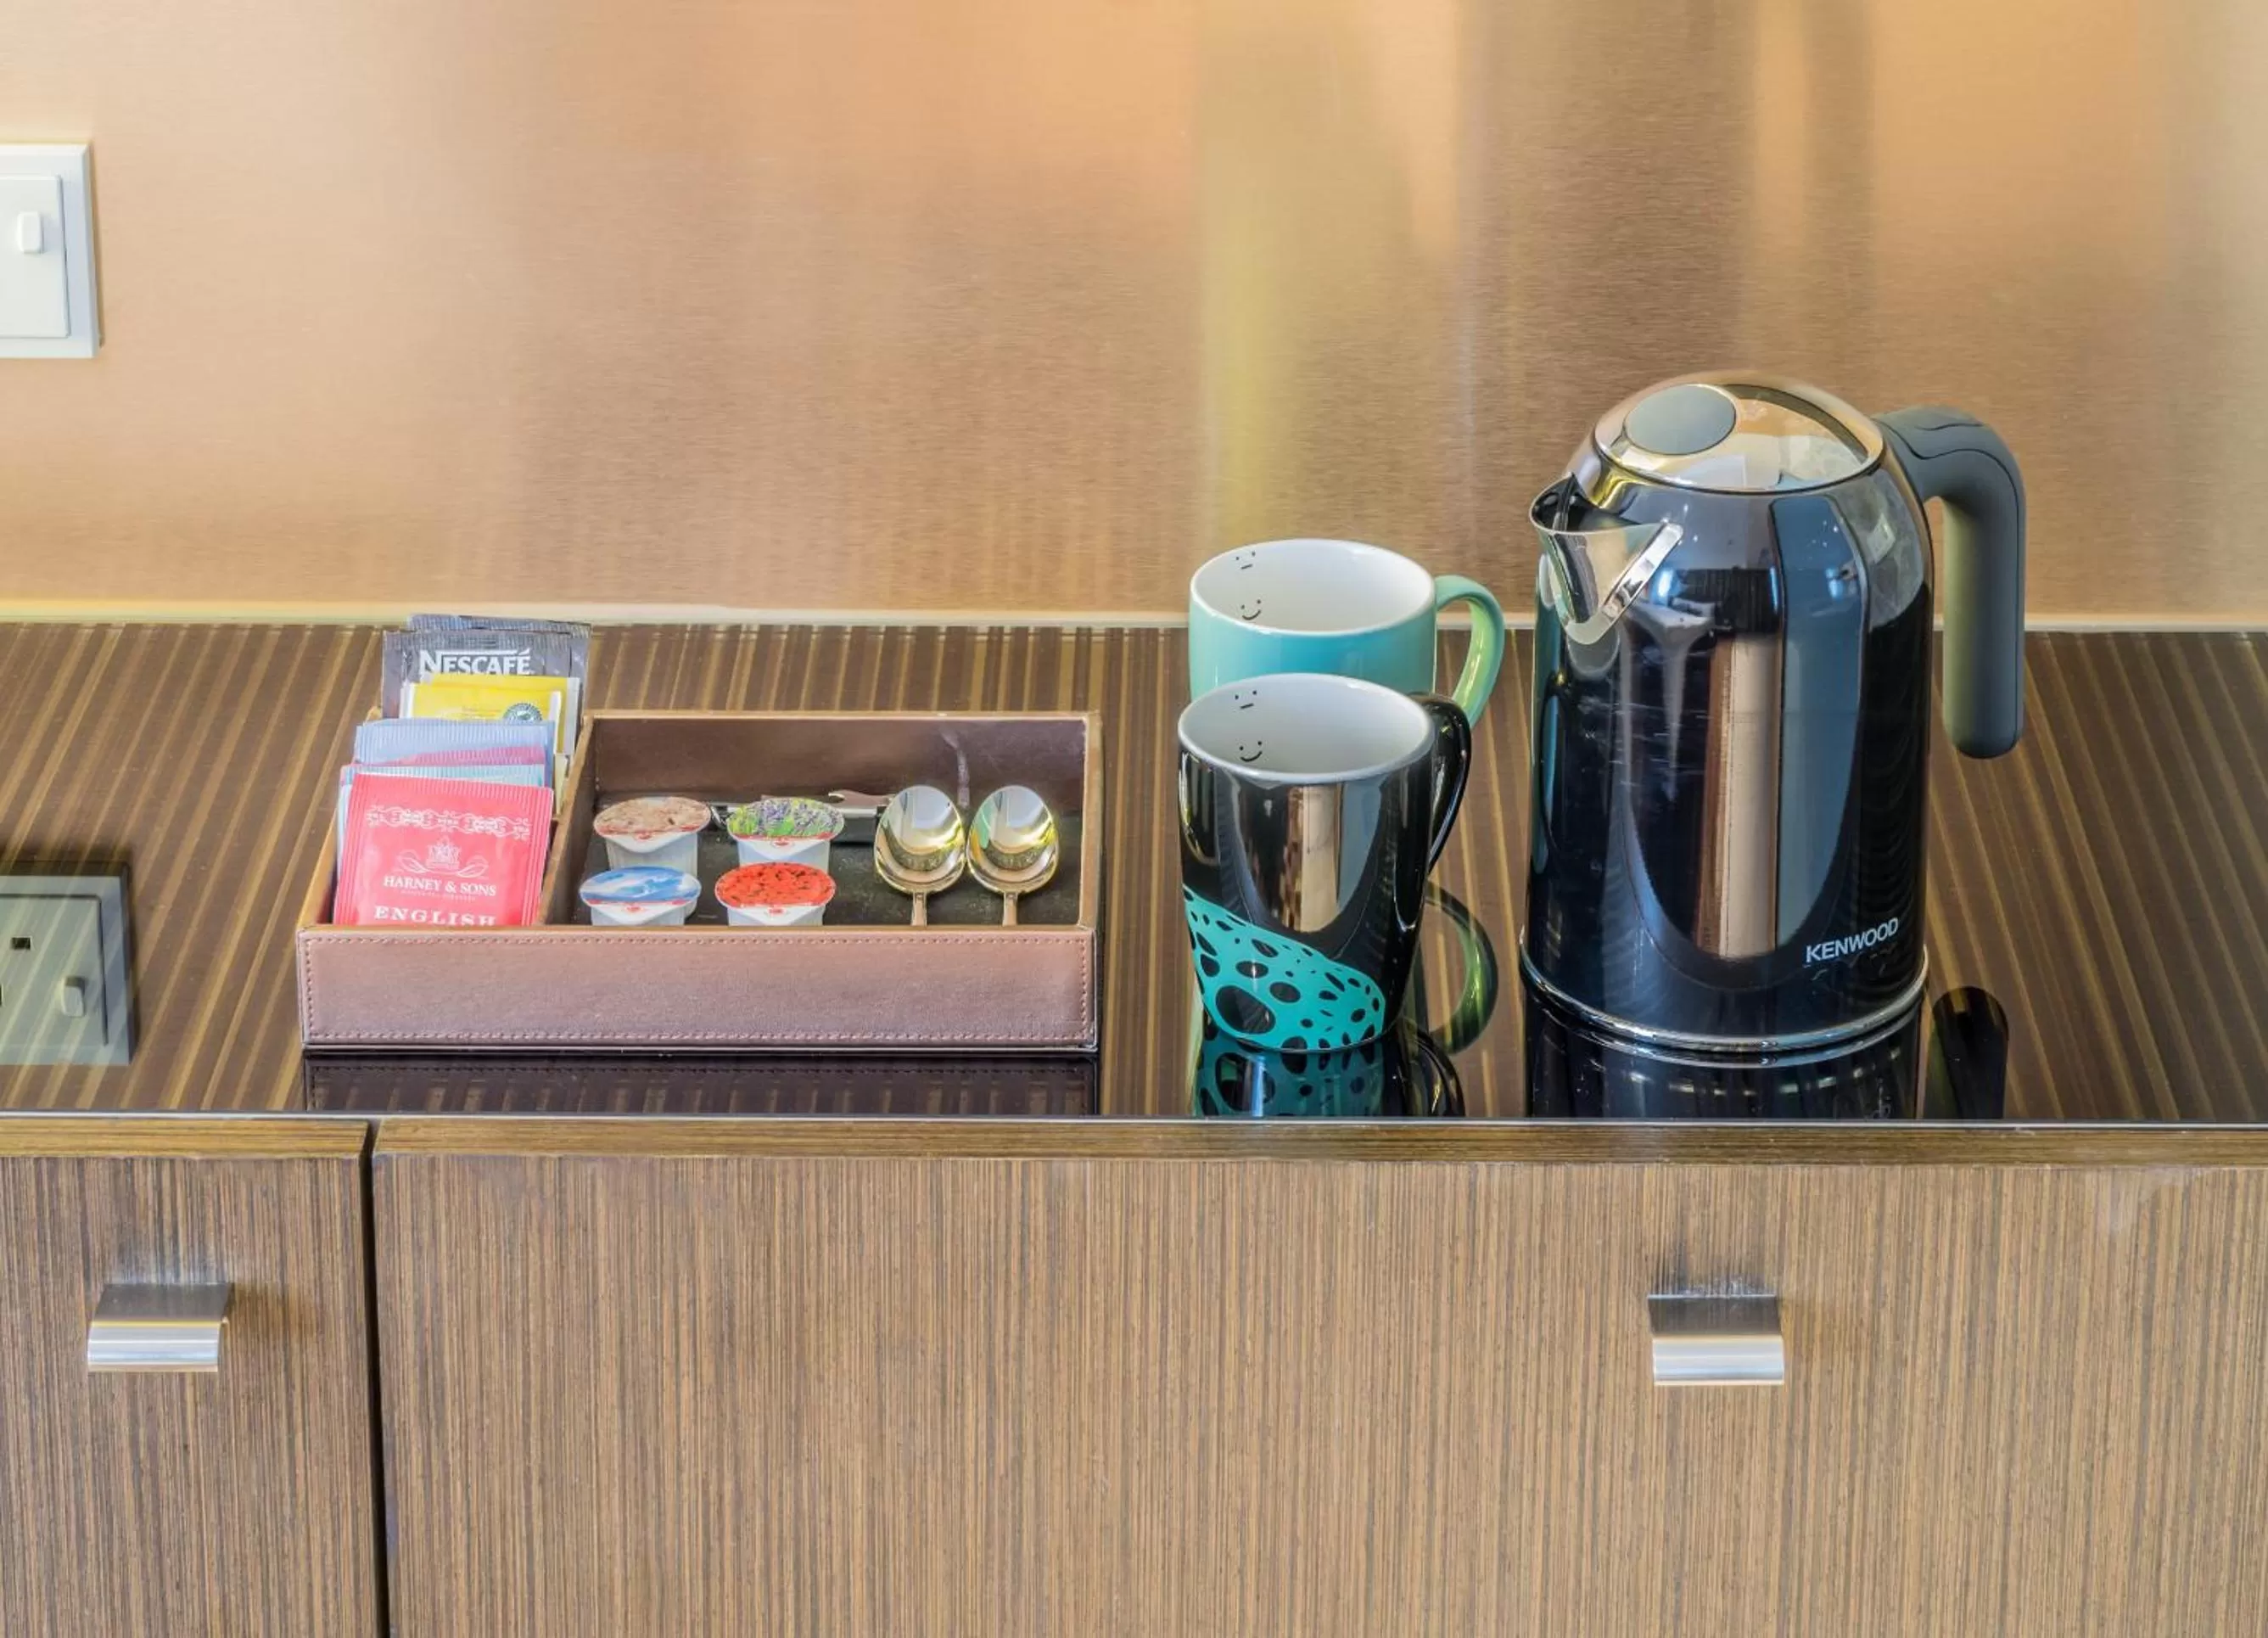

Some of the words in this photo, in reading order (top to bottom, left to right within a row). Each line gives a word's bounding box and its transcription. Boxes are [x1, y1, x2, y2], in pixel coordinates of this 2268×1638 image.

[419, 648, 531, 676] NESCAFÉ
[384, 874, 442, 892] HARNEY
[445, 880, 457, 893] &
[460, 882, 497, 897] SONS
[373, 905, 496, 927] ENGLISH
[1806, 917, 1899, 963] KENWOOD
